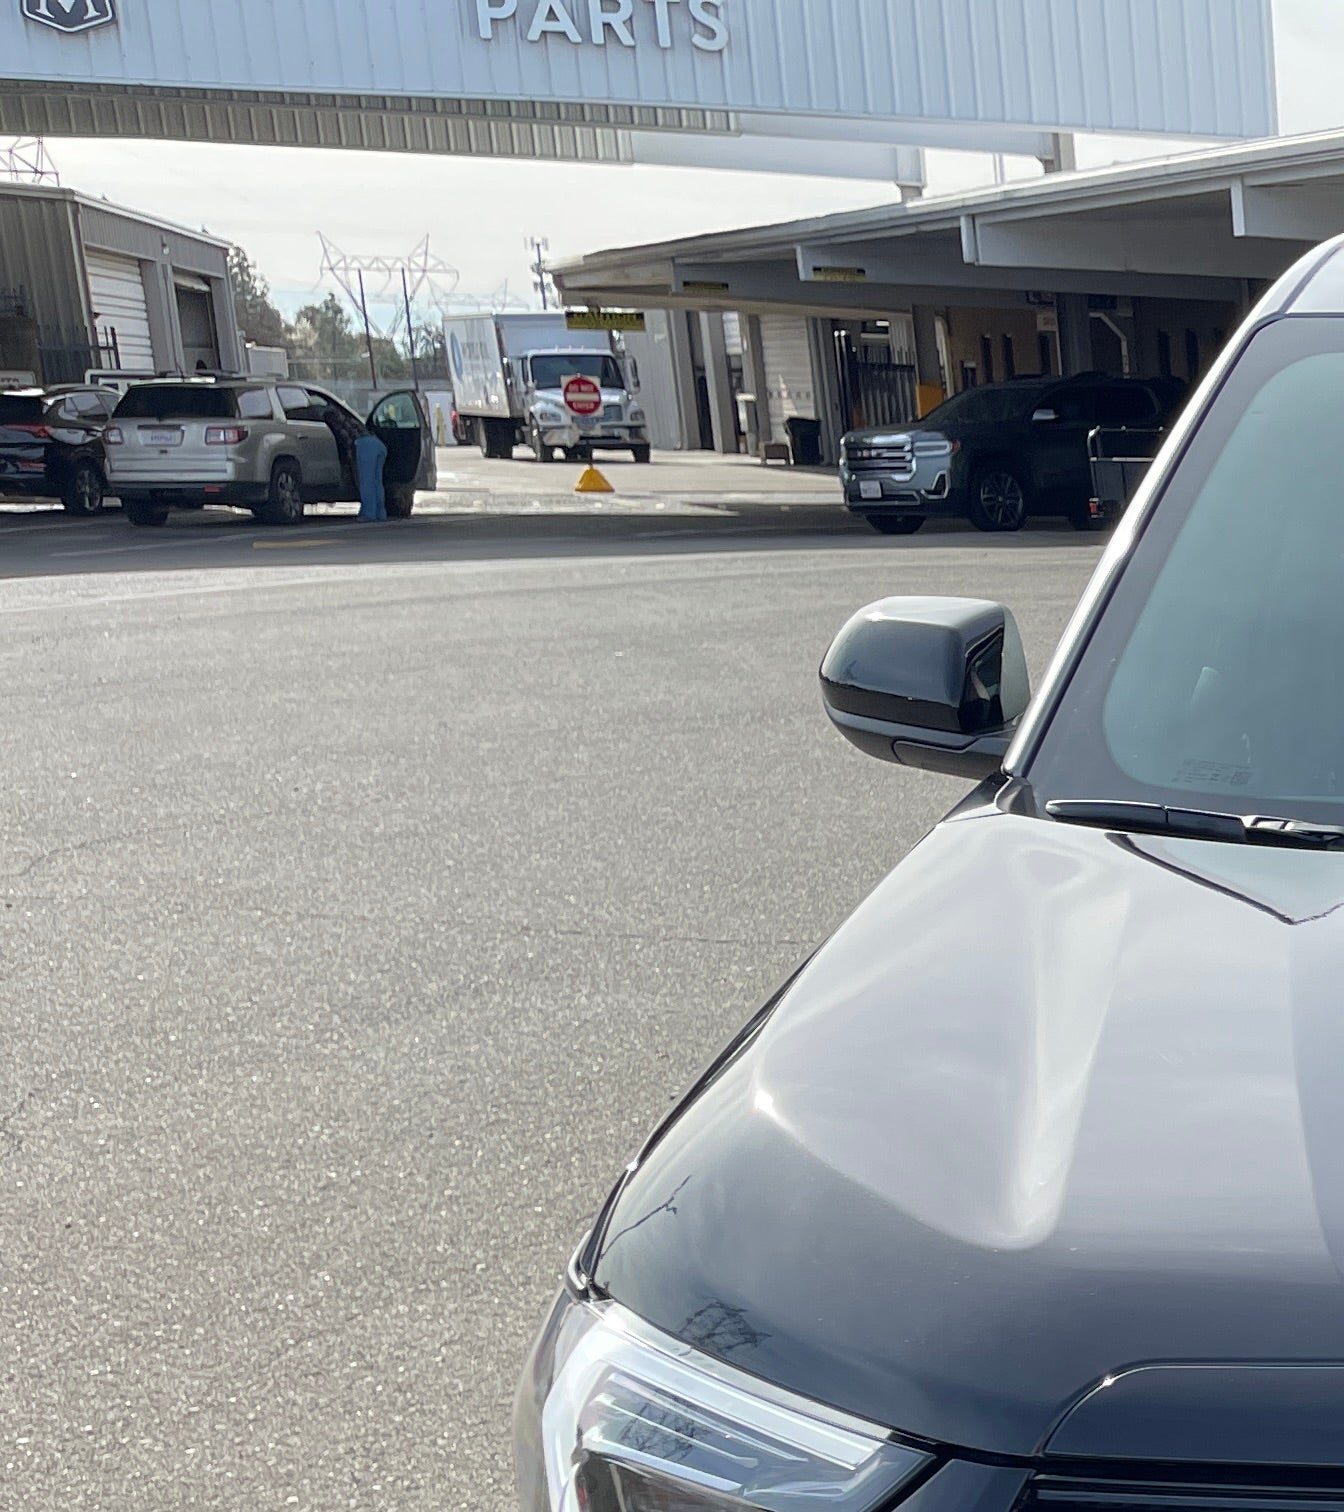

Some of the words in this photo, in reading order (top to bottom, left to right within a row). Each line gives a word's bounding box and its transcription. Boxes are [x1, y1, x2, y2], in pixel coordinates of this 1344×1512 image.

[475, 0, 729, 51] PARTS
[568, 383, 579, 393] DO
[580, 383, 595, 393] NOT
